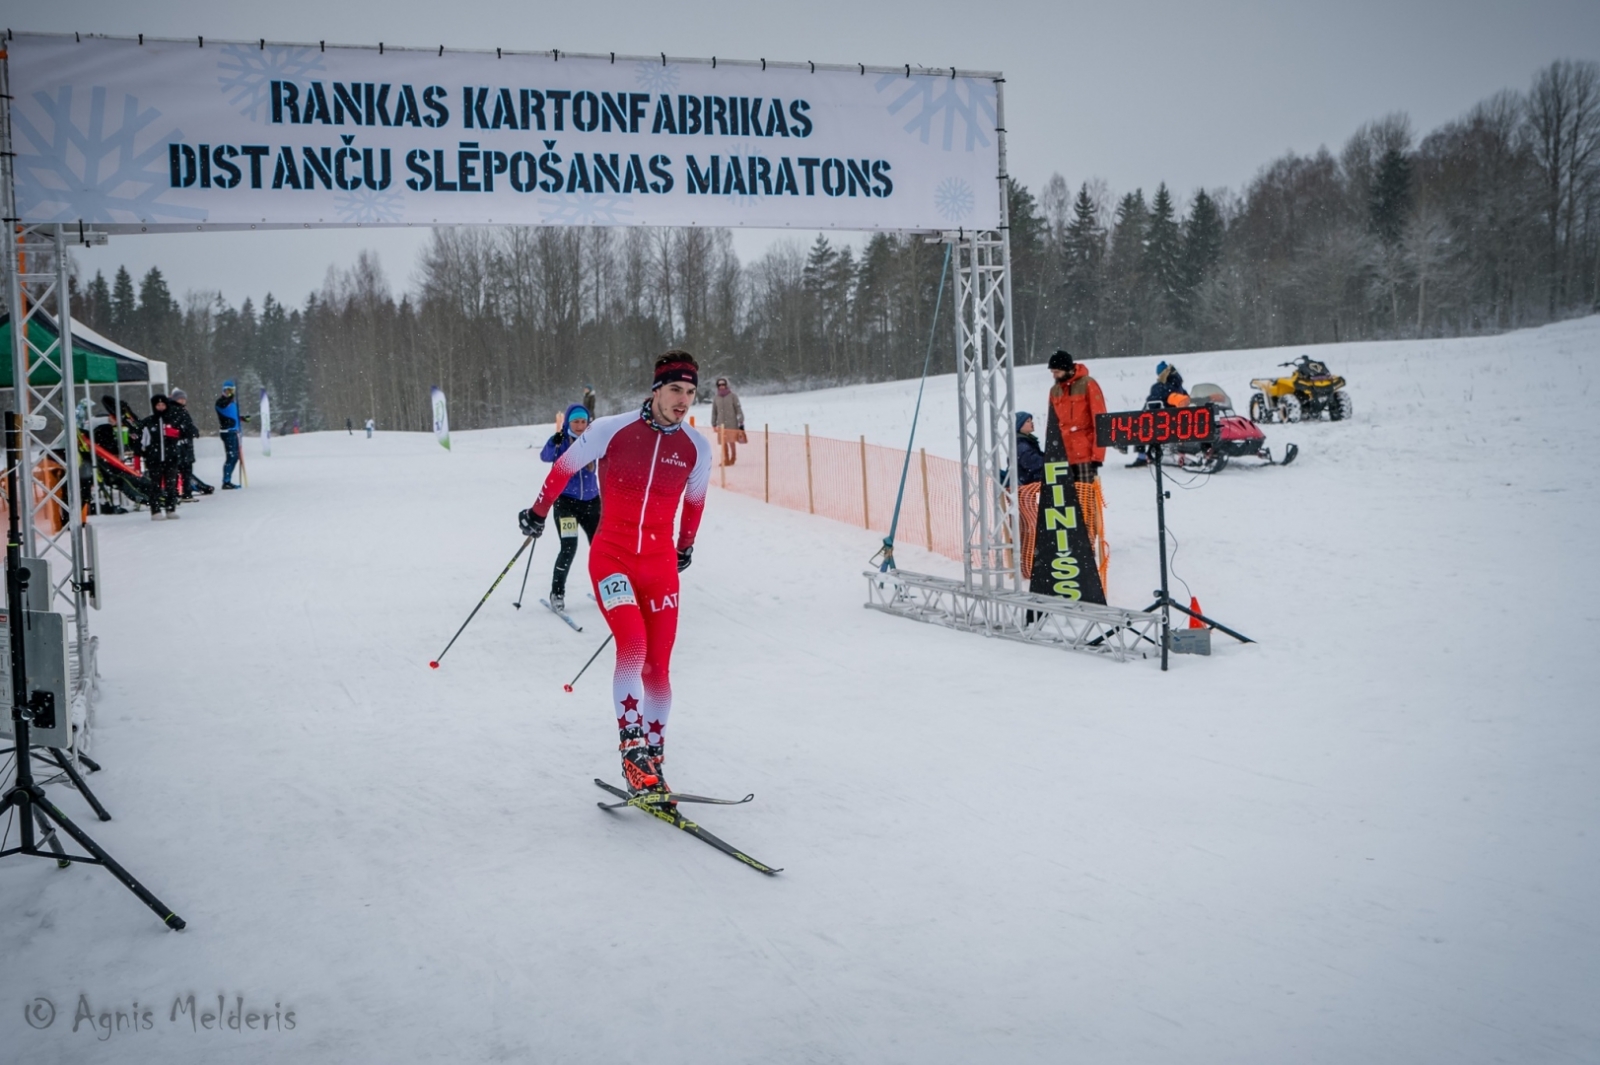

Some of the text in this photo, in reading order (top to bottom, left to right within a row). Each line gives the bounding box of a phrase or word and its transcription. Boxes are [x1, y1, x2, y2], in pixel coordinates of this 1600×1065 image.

[270, 80, 813, 138] RANKAS KARTONFABRIKAS
[168, 134, 893, 198] DISTANČU SLĒPOŠANAS MARATONS
[1111, 408, 1210, 442] 14:03:00
[660, 457, 687, 468] LATVIJA
[562, 522, 576, 530] 201
[604, 580, 628, 596] 127
